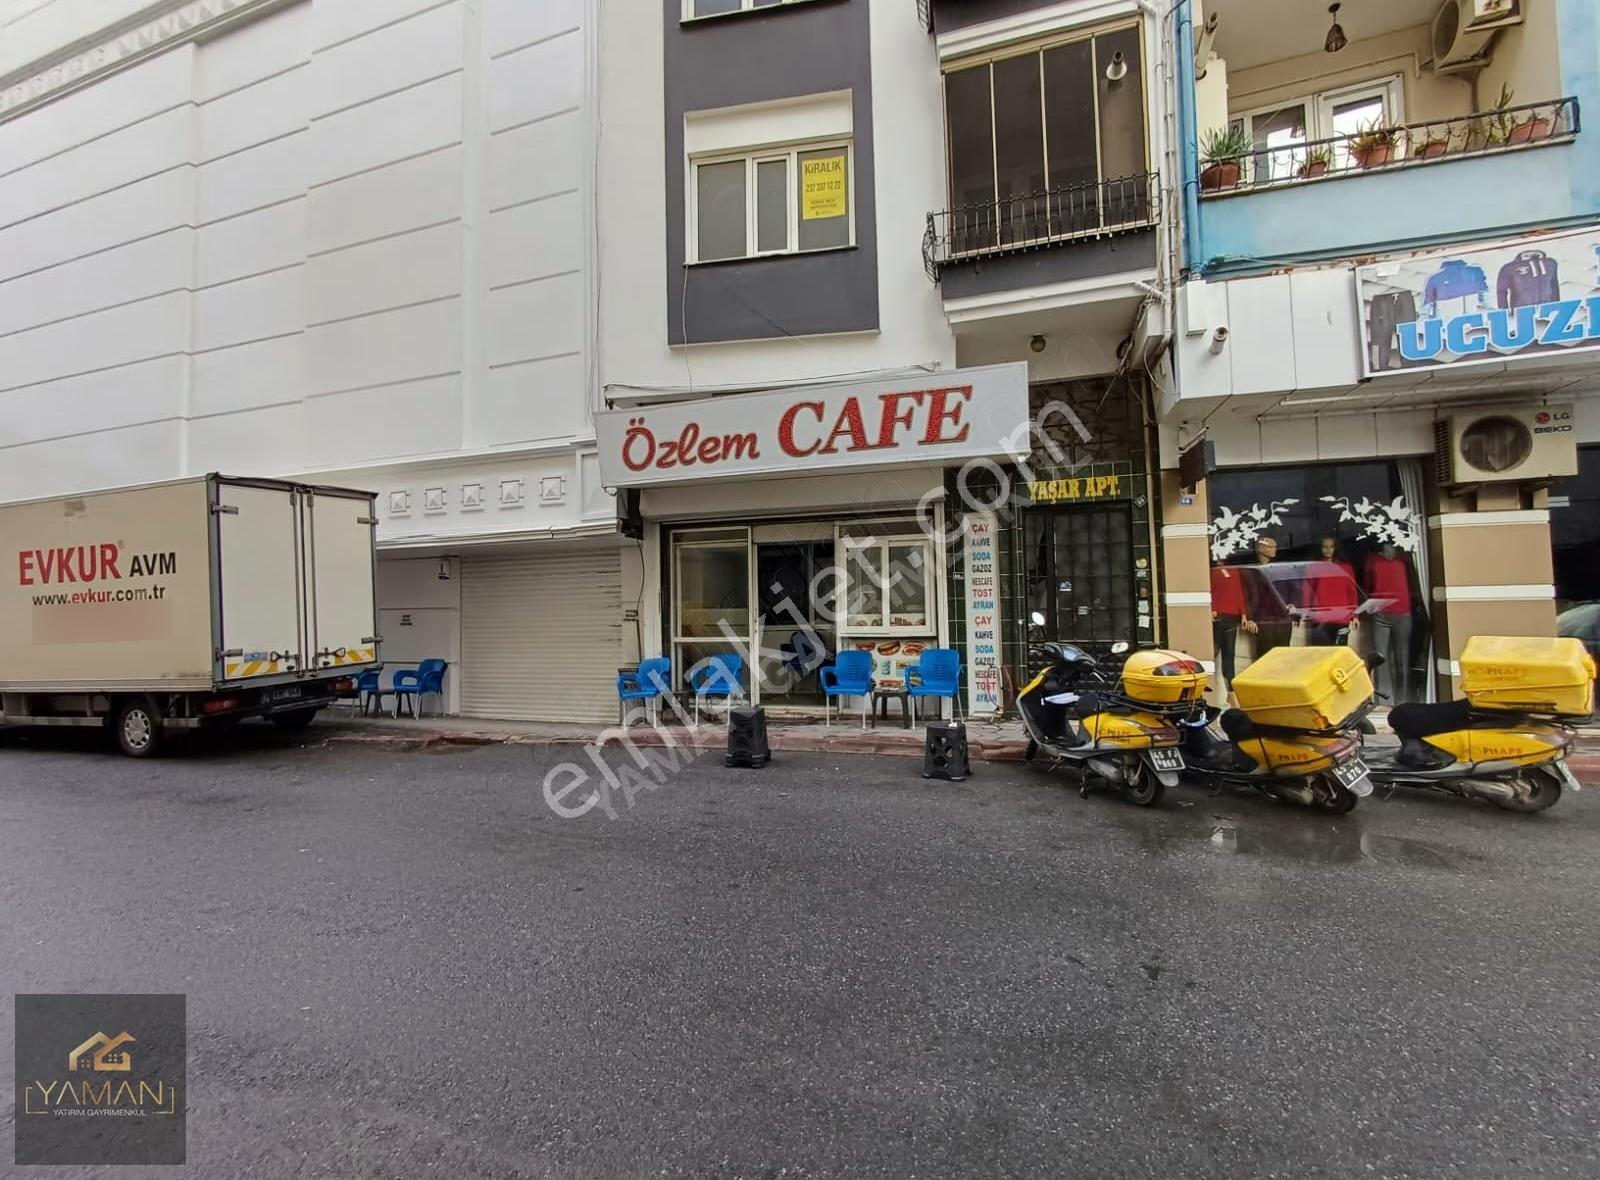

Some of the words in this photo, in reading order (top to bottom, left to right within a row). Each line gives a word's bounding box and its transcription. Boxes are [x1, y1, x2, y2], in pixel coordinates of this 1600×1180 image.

[1553, 412, 1570, 420] LG
[622, 417, 759, 472] Özlem
[778, 385, 973, 458] CAFE
[1027, 480, 1080, 504] YAŞAR
[1085, 476, 1120, 497] APT.
[972, 524, 989, 535] ÇAY
[972, 552, 992, 561] SODA
[19, 543, 122, 586] EVKUR
[129, 552, 177, 578] AVM
[32, 585, 166, 606] www.evkur.com.tr
[973, 589, 993, 597] TOST
[973, 601, 994, 609] AYRAN
[975, 616, 992, 627] ÇAY
[975, 630, 993, 639] KAHVE
[975, 645, 994, 654] SODA
[976, 681, 996, 691] TOST
